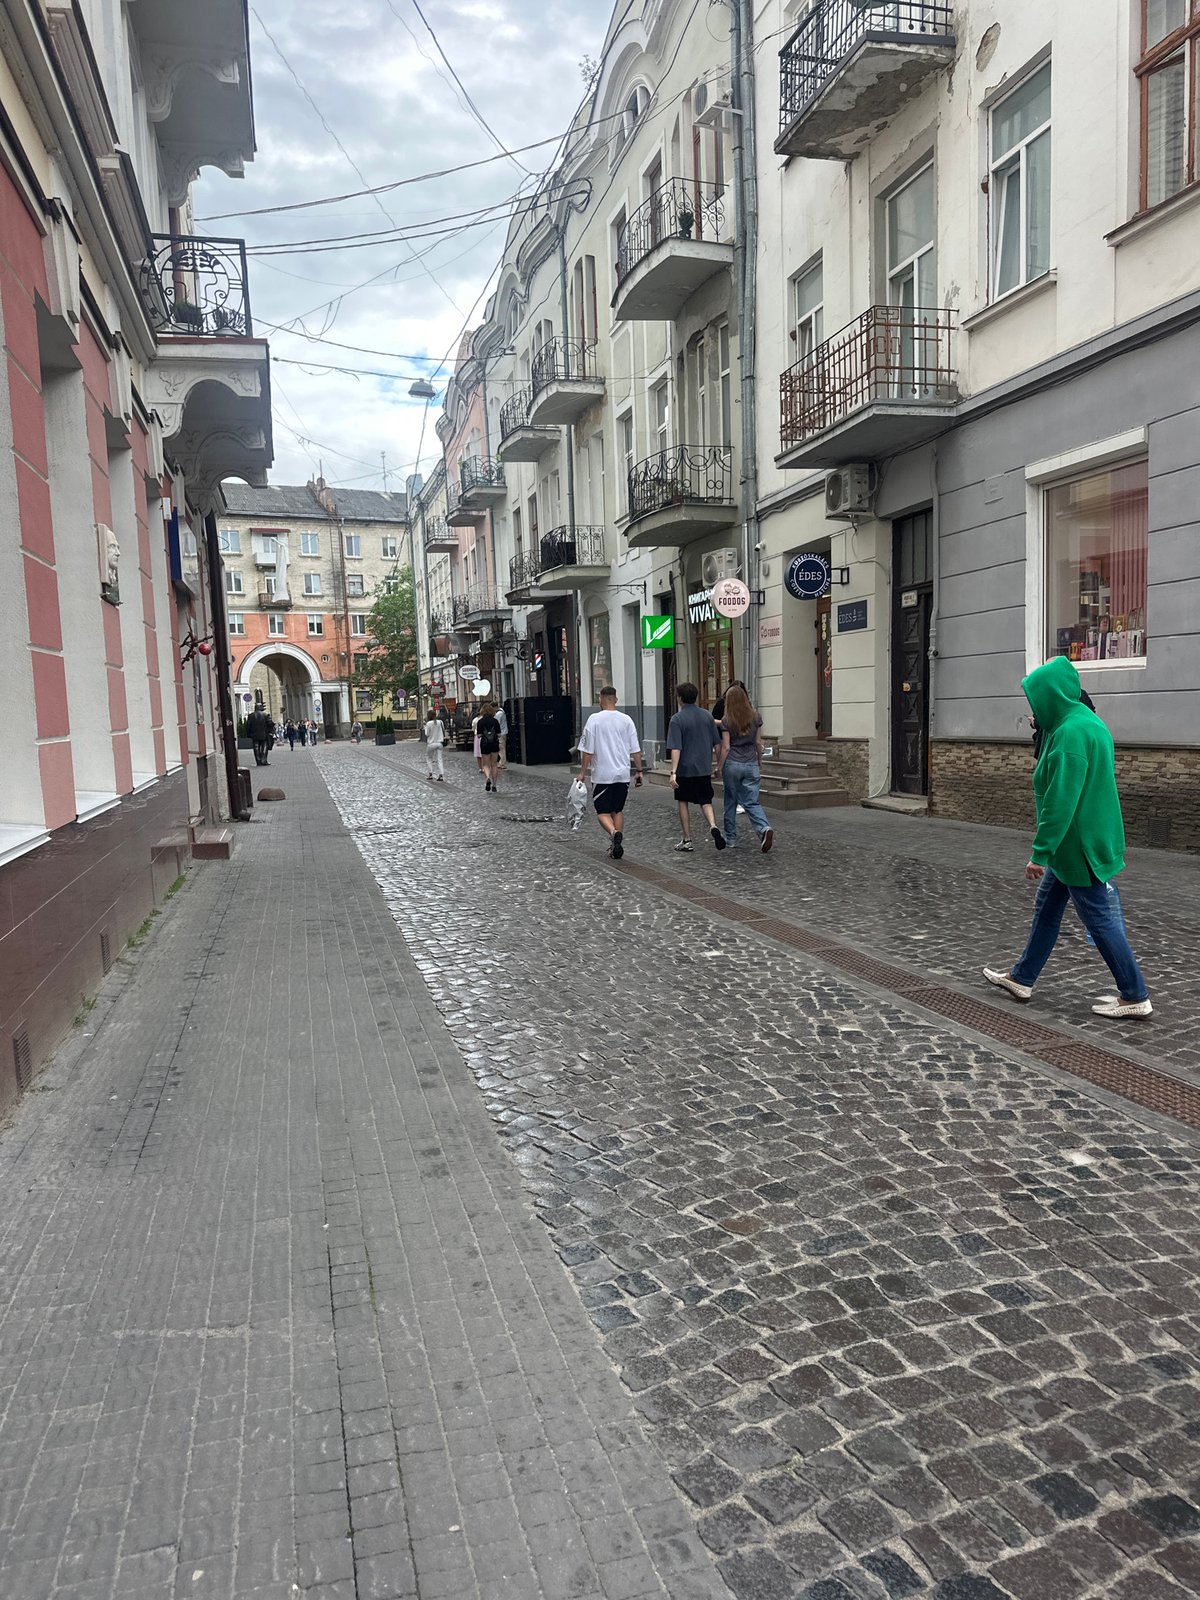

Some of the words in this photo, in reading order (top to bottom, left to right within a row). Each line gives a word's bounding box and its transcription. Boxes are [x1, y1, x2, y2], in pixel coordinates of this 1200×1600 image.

[798, 568, 822, 581] ÉDES
[790, 578, 805, 598] COFFEE
[814, 577, 831, 598] MATCHA
[688, 588, 714, 605] КНИГАРН
[718, 597, 746, 606] FOODOS
